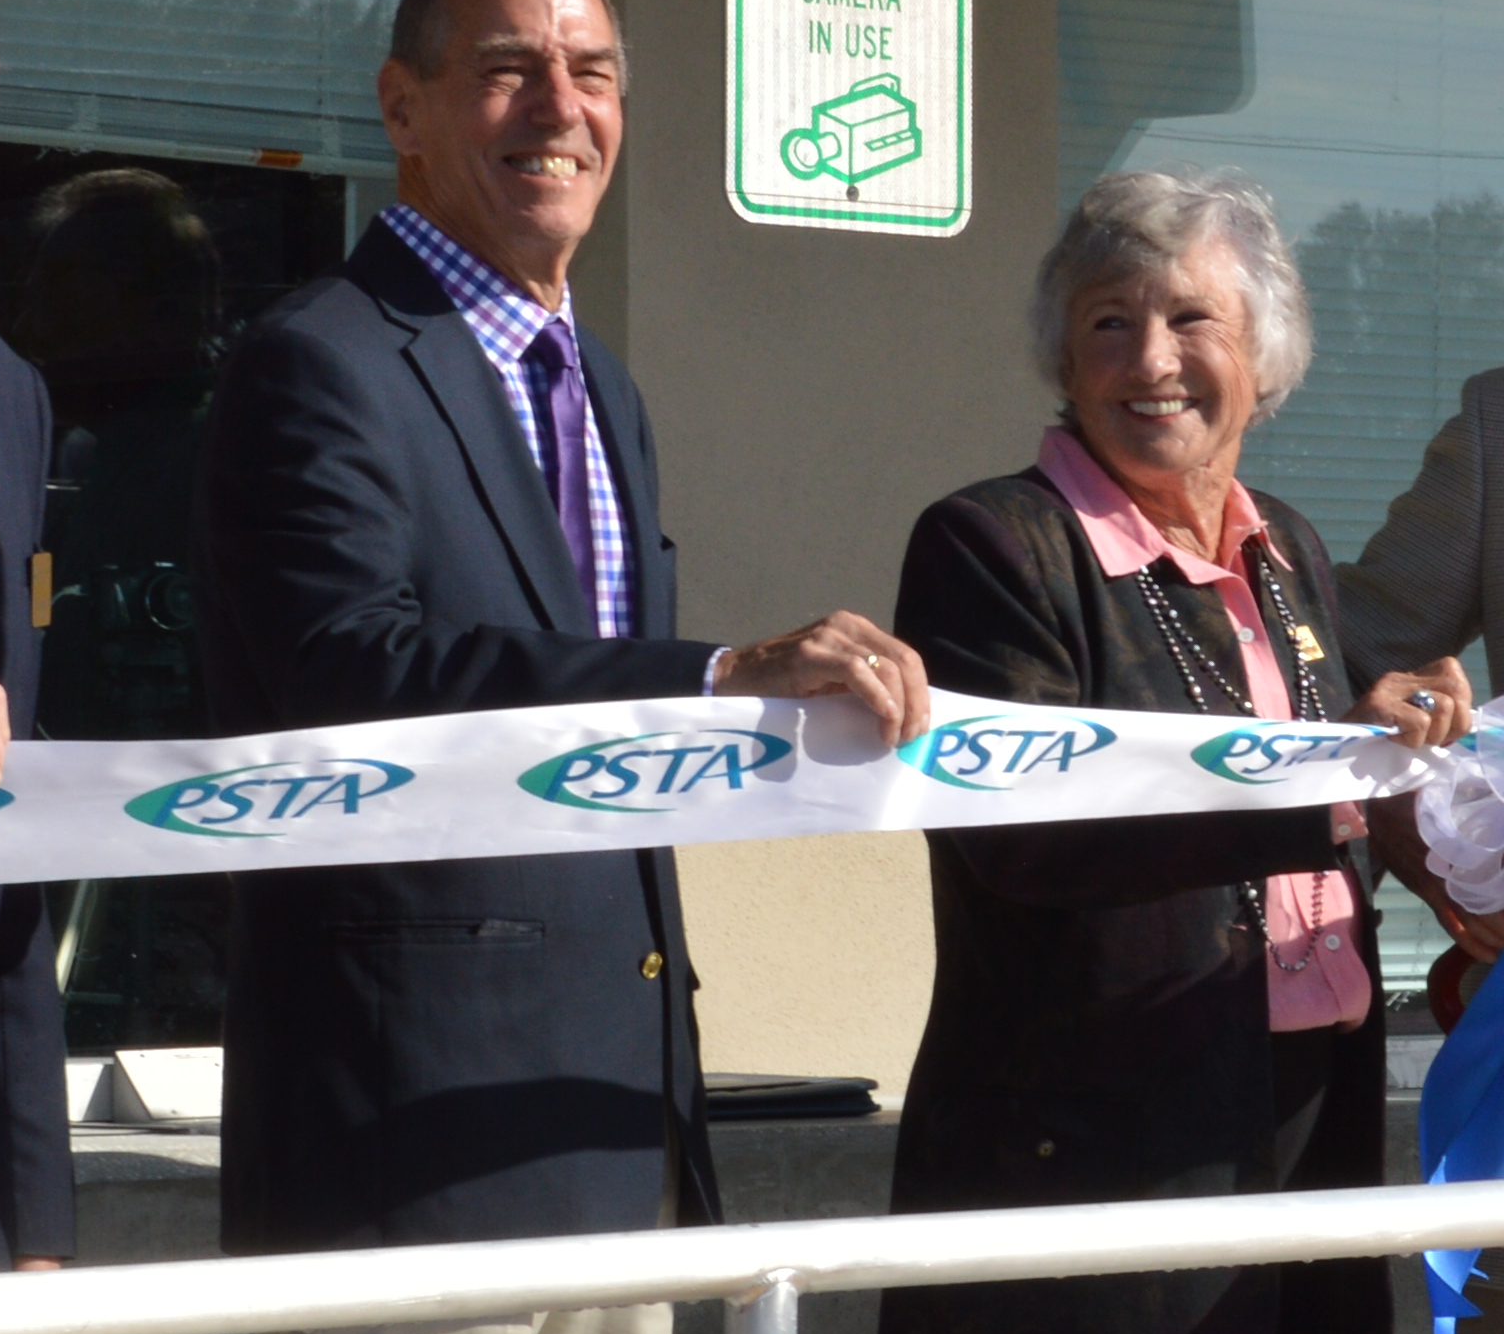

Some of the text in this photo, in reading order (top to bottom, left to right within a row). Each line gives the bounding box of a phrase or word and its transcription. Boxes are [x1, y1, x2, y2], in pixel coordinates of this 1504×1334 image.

[809, 19, 893, 60] IN USE
[152, 773, 362, 828] PSTA
[543, 743, 745, 803] PSTA
[922, 728, 1078, 777] PSTA
